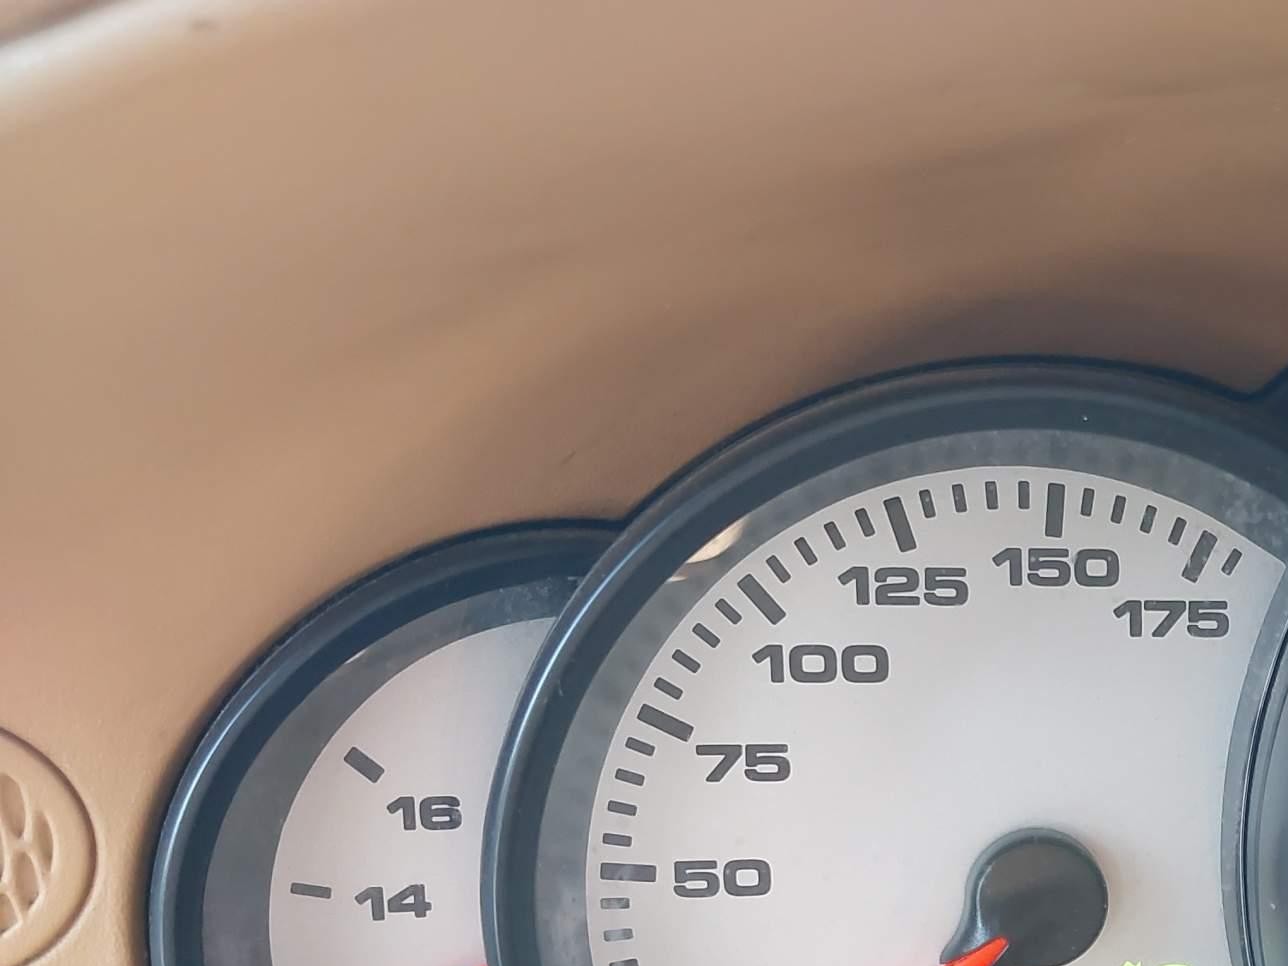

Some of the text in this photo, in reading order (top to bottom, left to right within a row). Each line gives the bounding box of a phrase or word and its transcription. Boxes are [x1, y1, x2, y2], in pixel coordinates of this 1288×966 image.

[838, 566, 969, 606] 125
[992, 548, 1120, 588] 150
[1113, 600, 1229, 639] 175
[752, 644, 890, 684] 100
[695, 744, 792, 782] 75
[387, 796, 462, 831] 16
[673, 860, 772, 897] 50
[355, 884, 432, 921] 14
